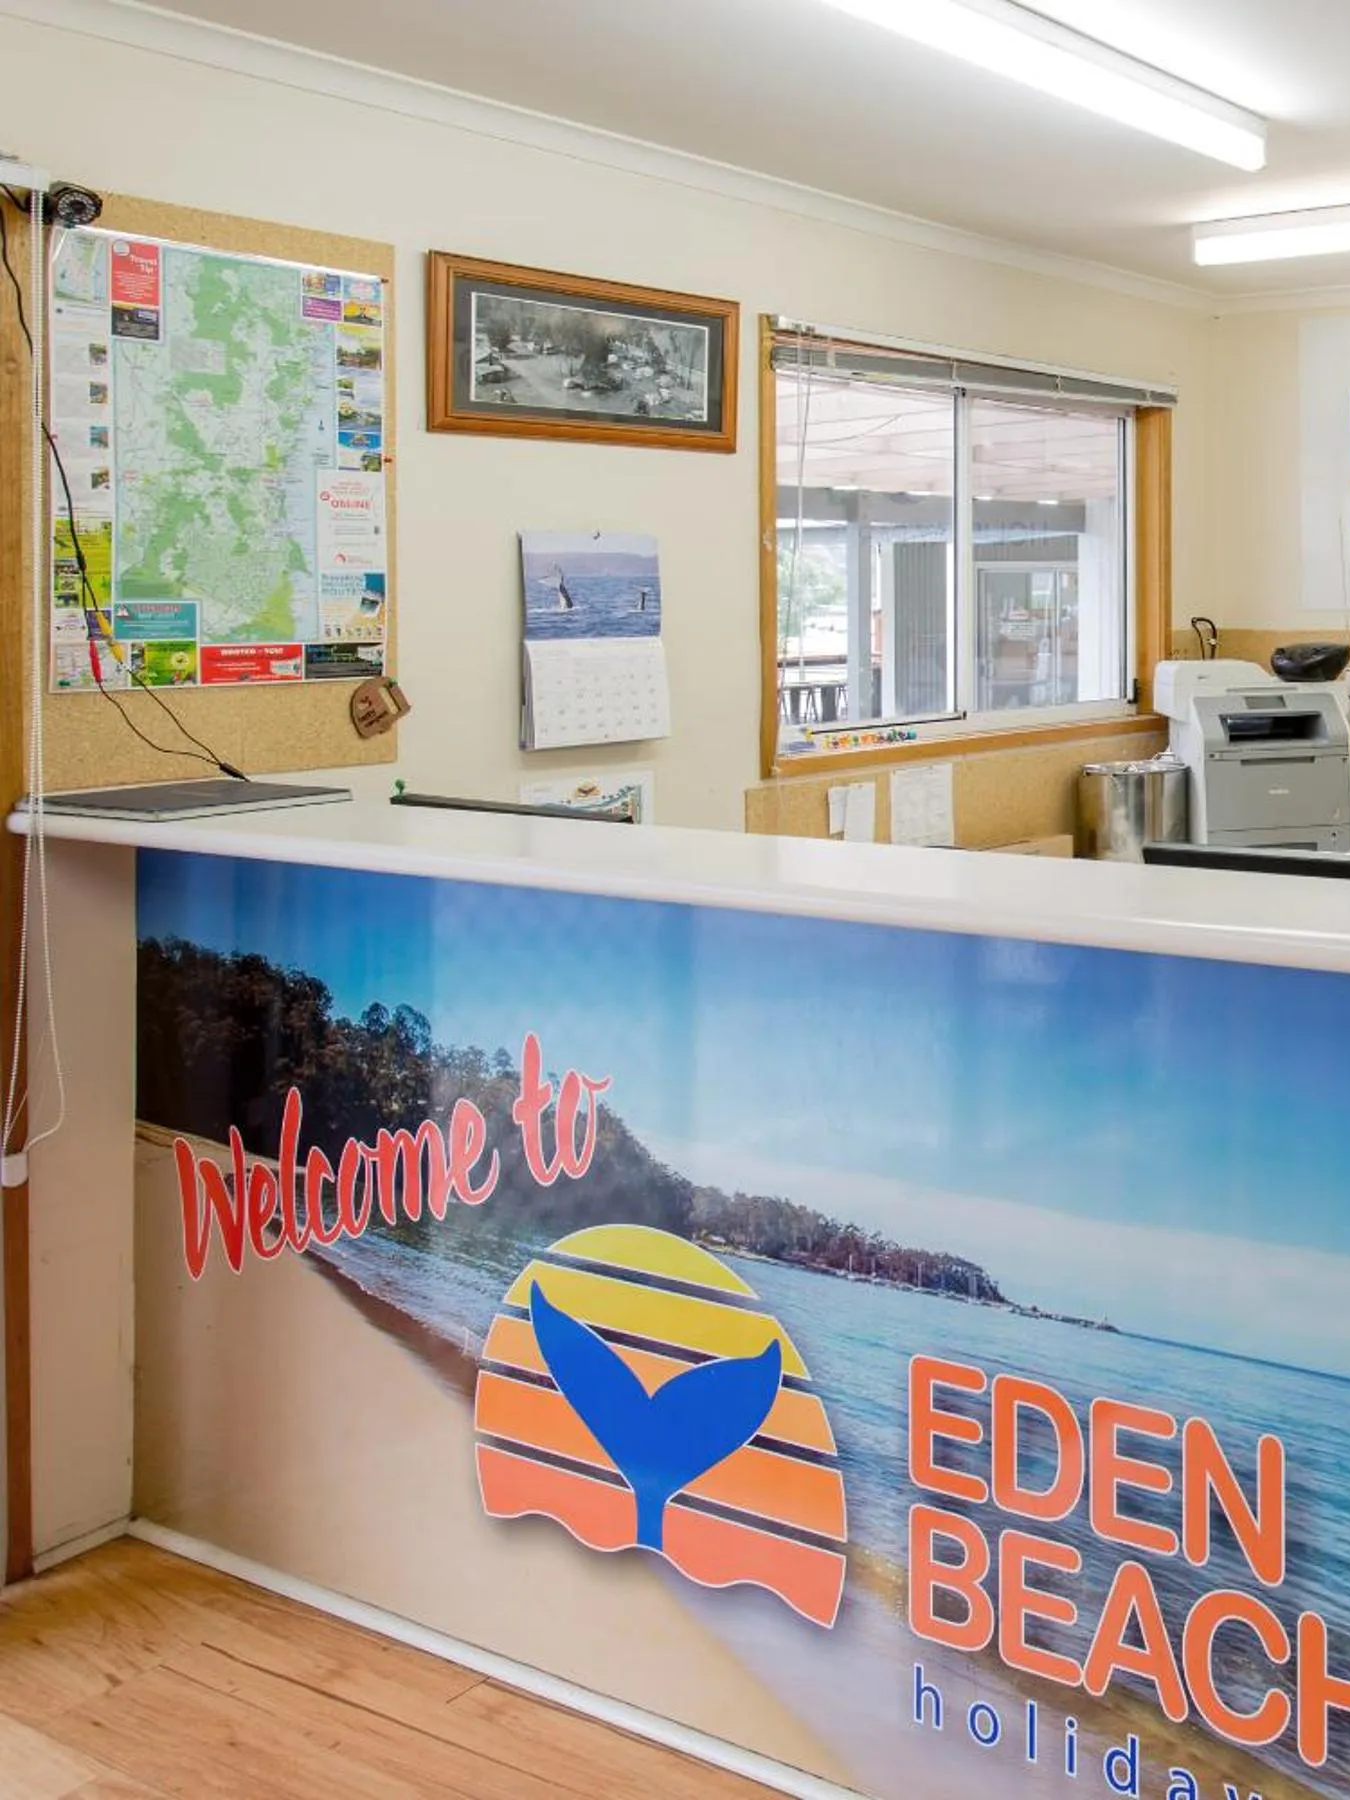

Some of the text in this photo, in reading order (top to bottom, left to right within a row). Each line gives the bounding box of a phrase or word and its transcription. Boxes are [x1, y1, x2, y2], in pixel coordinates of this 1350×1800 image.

[173, 1029, 613, 1281] Welcome to
[908, 1353, 1286, 1588] EDEN
[912, 1662, 1263, 1800] holida
